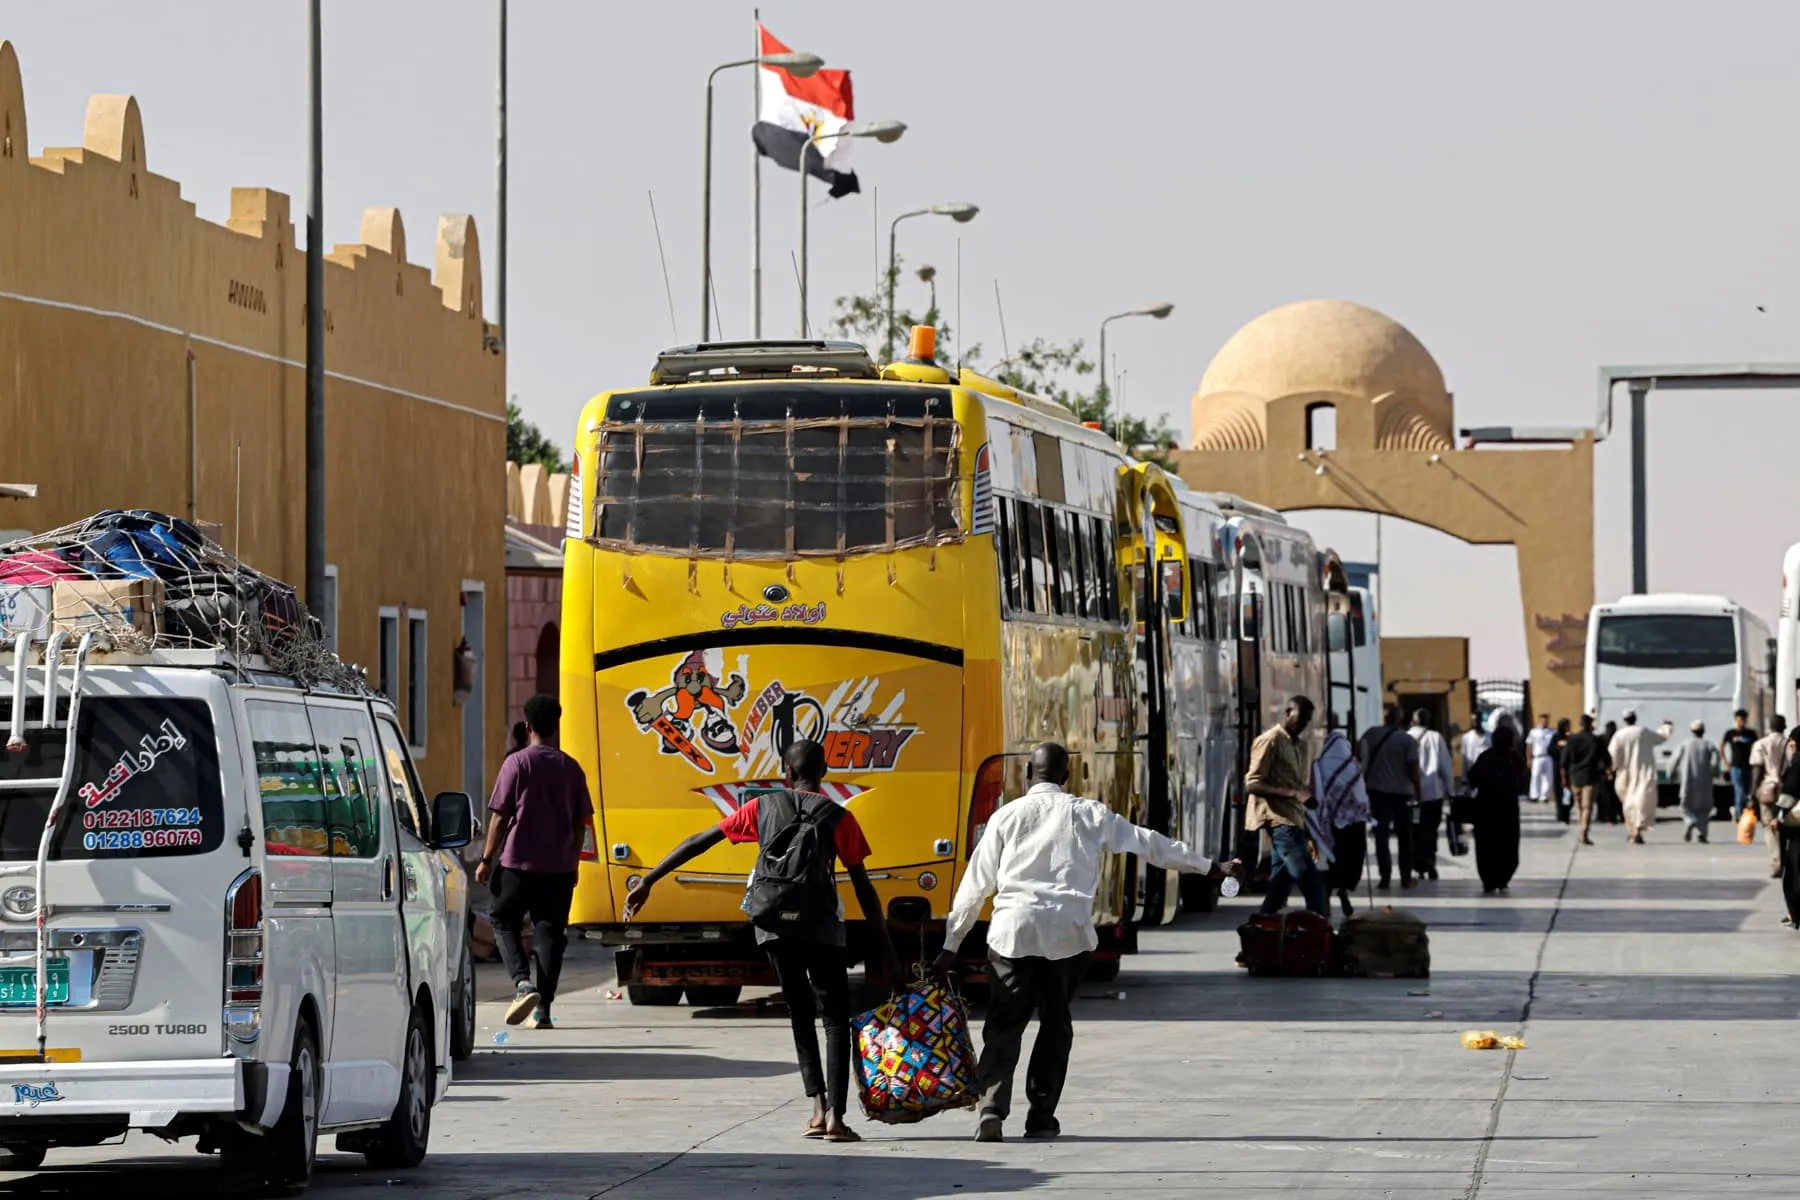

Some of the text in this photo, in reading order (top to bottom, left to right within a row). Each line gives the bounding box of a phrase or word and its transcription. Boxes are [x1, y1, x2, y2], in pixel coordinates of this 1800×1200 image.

[84, 808, 201, 829] 0122187624
[84, 829, 202, 850] 0128896079
[108, 1023, 208, 1036] 2500 TURBO
